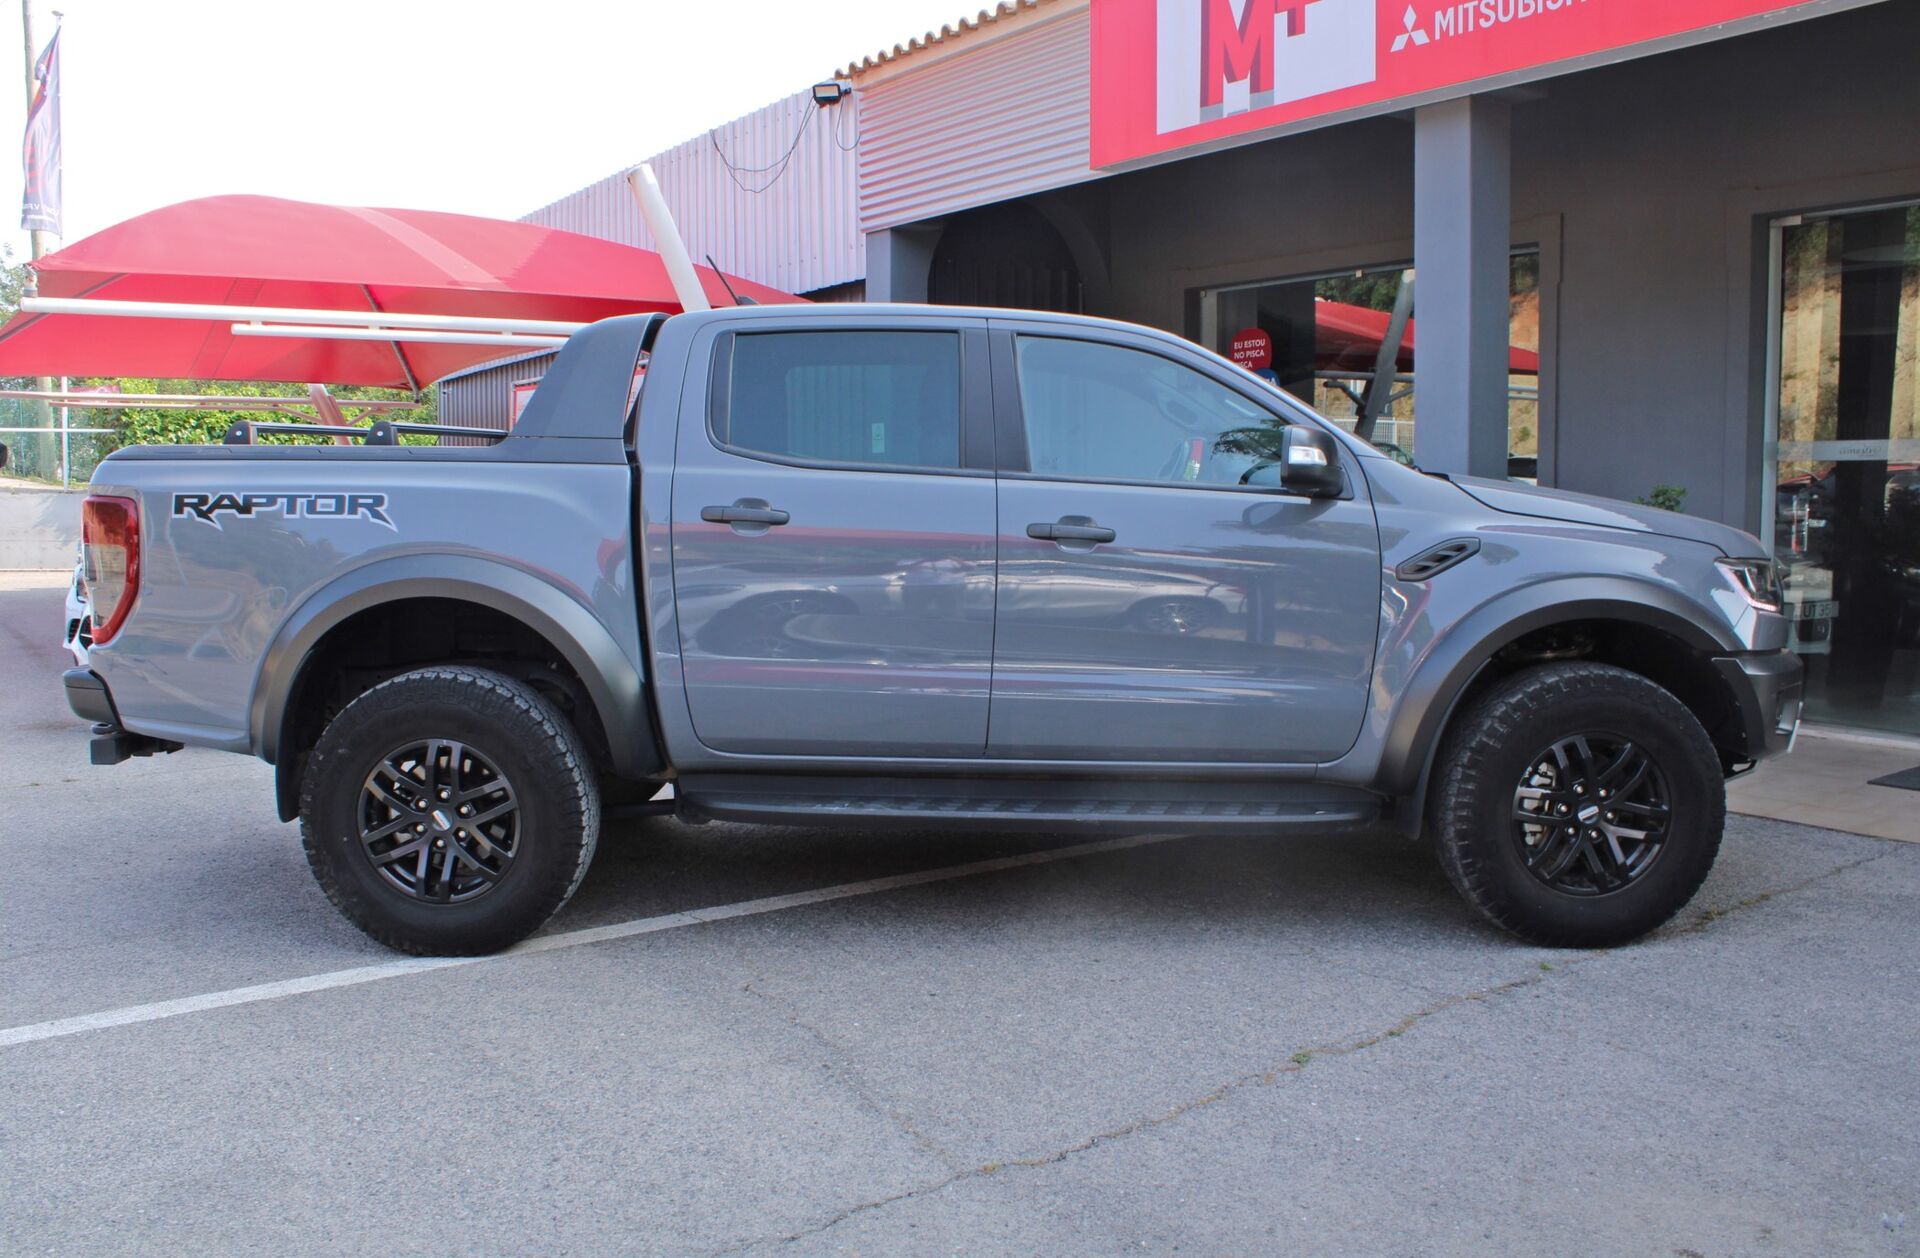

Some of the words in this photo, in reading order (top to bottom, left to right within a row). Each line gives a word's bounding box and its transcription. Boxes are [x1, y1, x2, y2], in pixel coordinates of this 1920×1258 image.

[1434, 0, 1587, 41] MITSUBI
[1244, 339, 1265, 348] ESTOU
[1246, 350, 1264, 358] PISCA
[172, 492, 399, 533] RAPTOR
